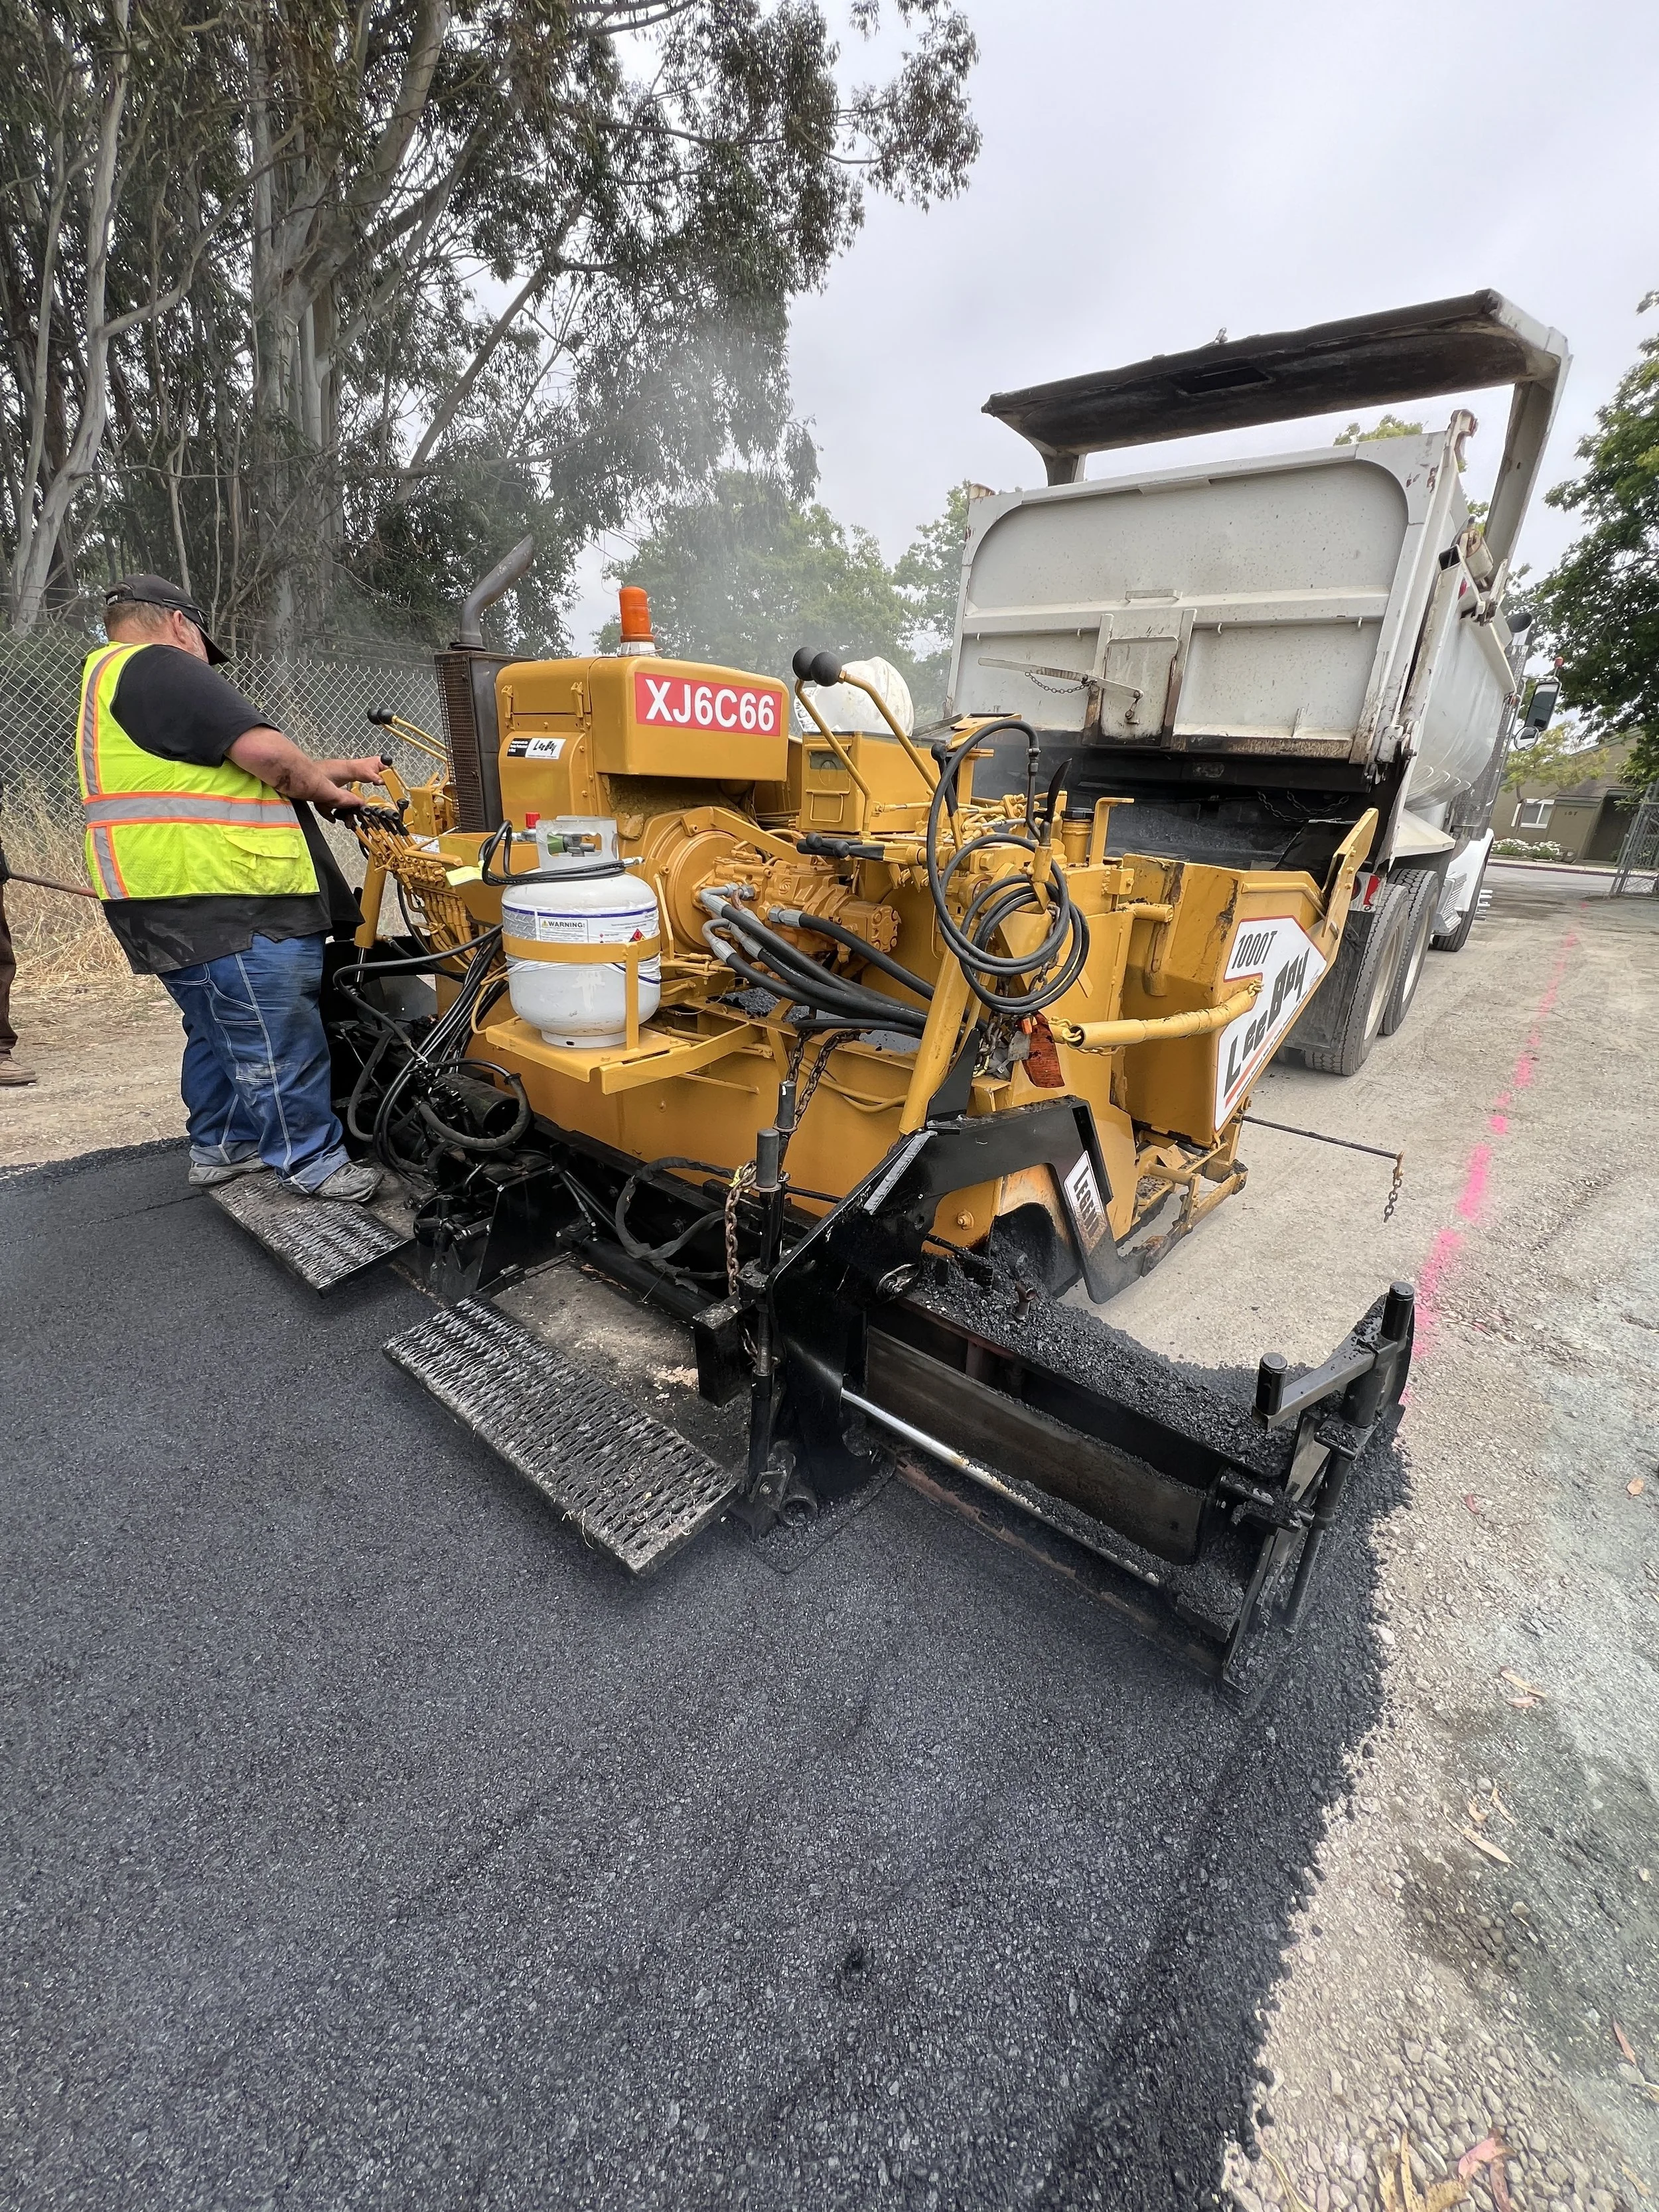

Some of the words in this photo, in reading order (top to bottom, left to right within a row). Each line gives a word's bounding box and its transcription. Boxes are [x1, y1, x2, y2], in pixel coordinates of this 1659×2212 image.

[645, 679, 774, 731] XJ6C66
[1232, 930, 1277, 969] 1000T
[1224, 947, 1310, 1098] LeeBoy
